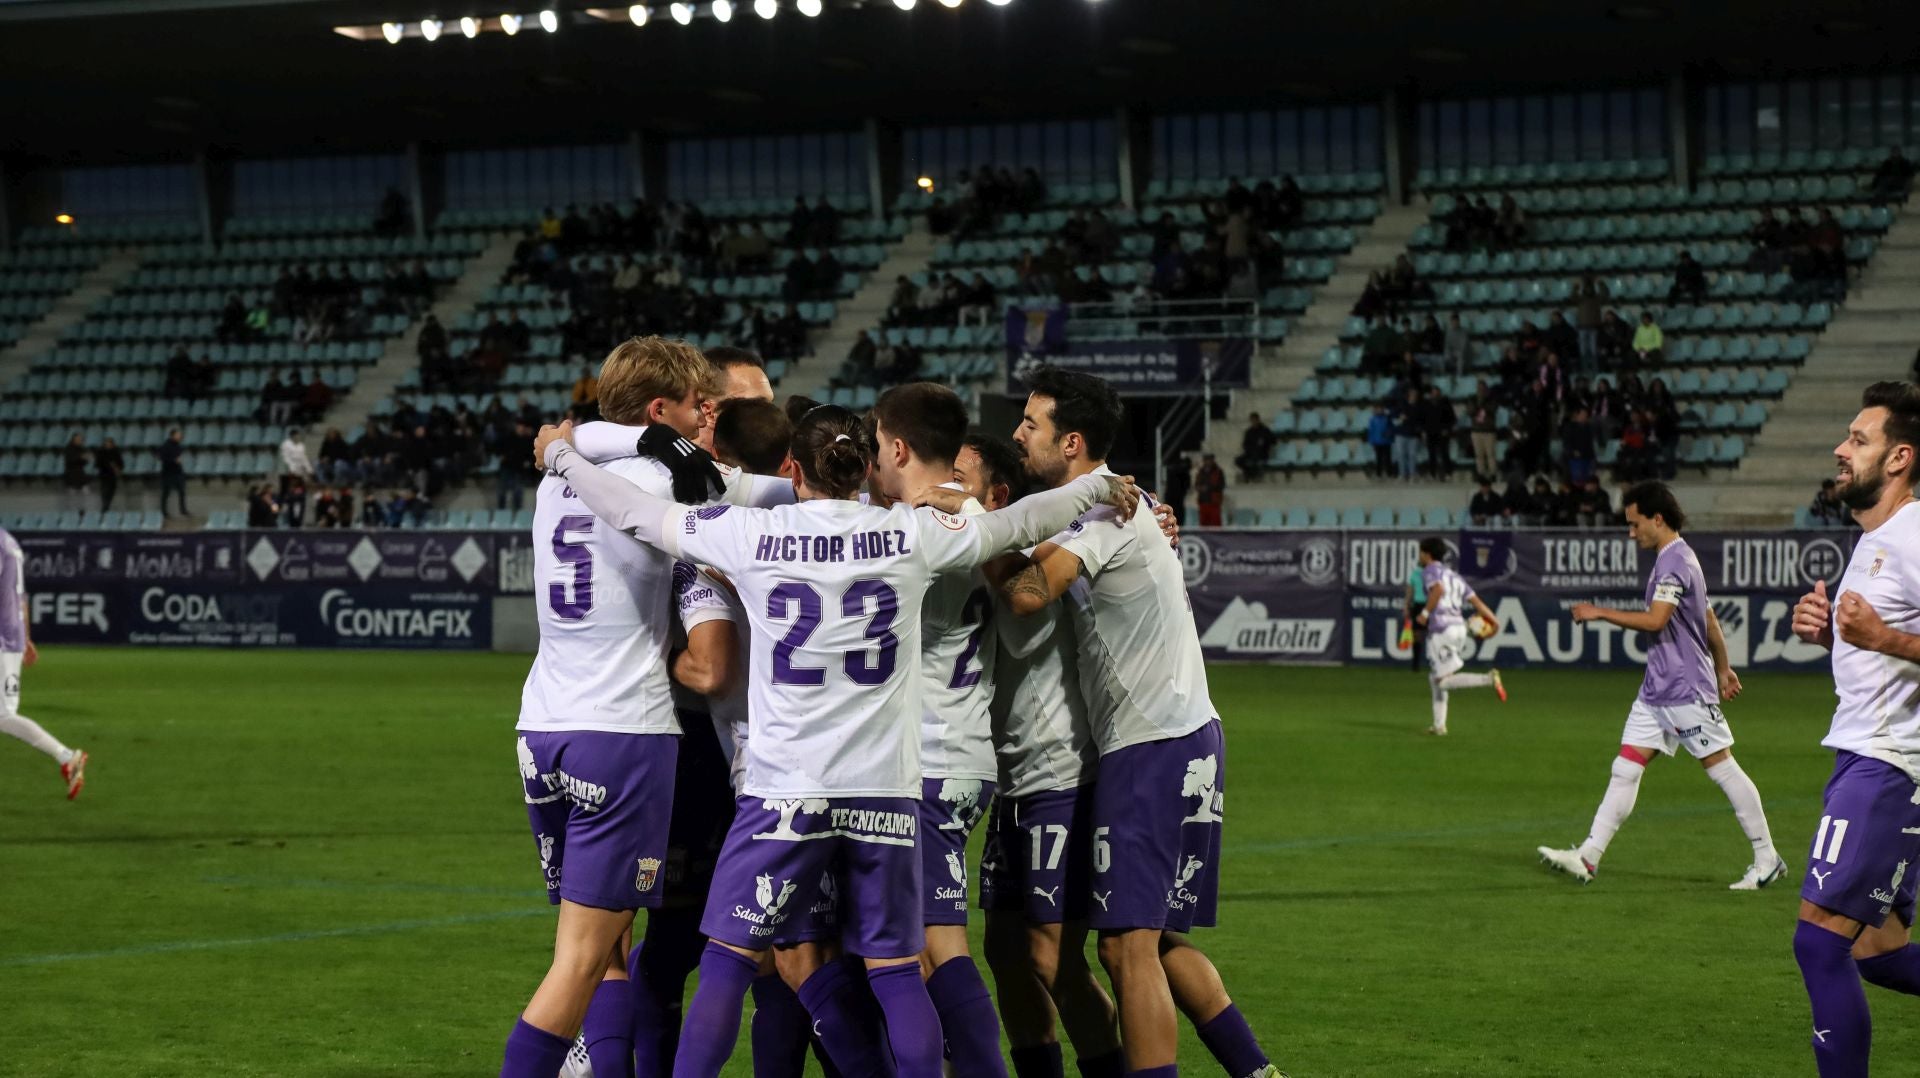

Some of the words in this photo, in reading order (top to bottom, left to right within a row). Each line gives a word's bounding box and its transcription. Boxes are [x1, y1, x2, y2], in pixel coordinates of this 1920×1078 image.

[852, 530, 911, 561] HDEZ
[1181, 542, 1202, 571] B
[1543, 539, 1639, 573] TERCERA
[24, 552, 77, 578] oMa
[549, 515, 596, 620] 5
[31, 592, 110, 633] FER
[335, 608, 473, 638] CONTAFIX
[766, 578, 900, 686] 23
[1236, 621, 1322, 648] antolin
[831, 808, 916, 836] TECNICAMPO
[1030, 824, 1069, 871] 17
[1093, 826, 1111, 873] 6
[1812, 815, 1849, 864] 11
[935, 887, 963, 900] Sdad
[732, 905, 767, 924] Sdad
